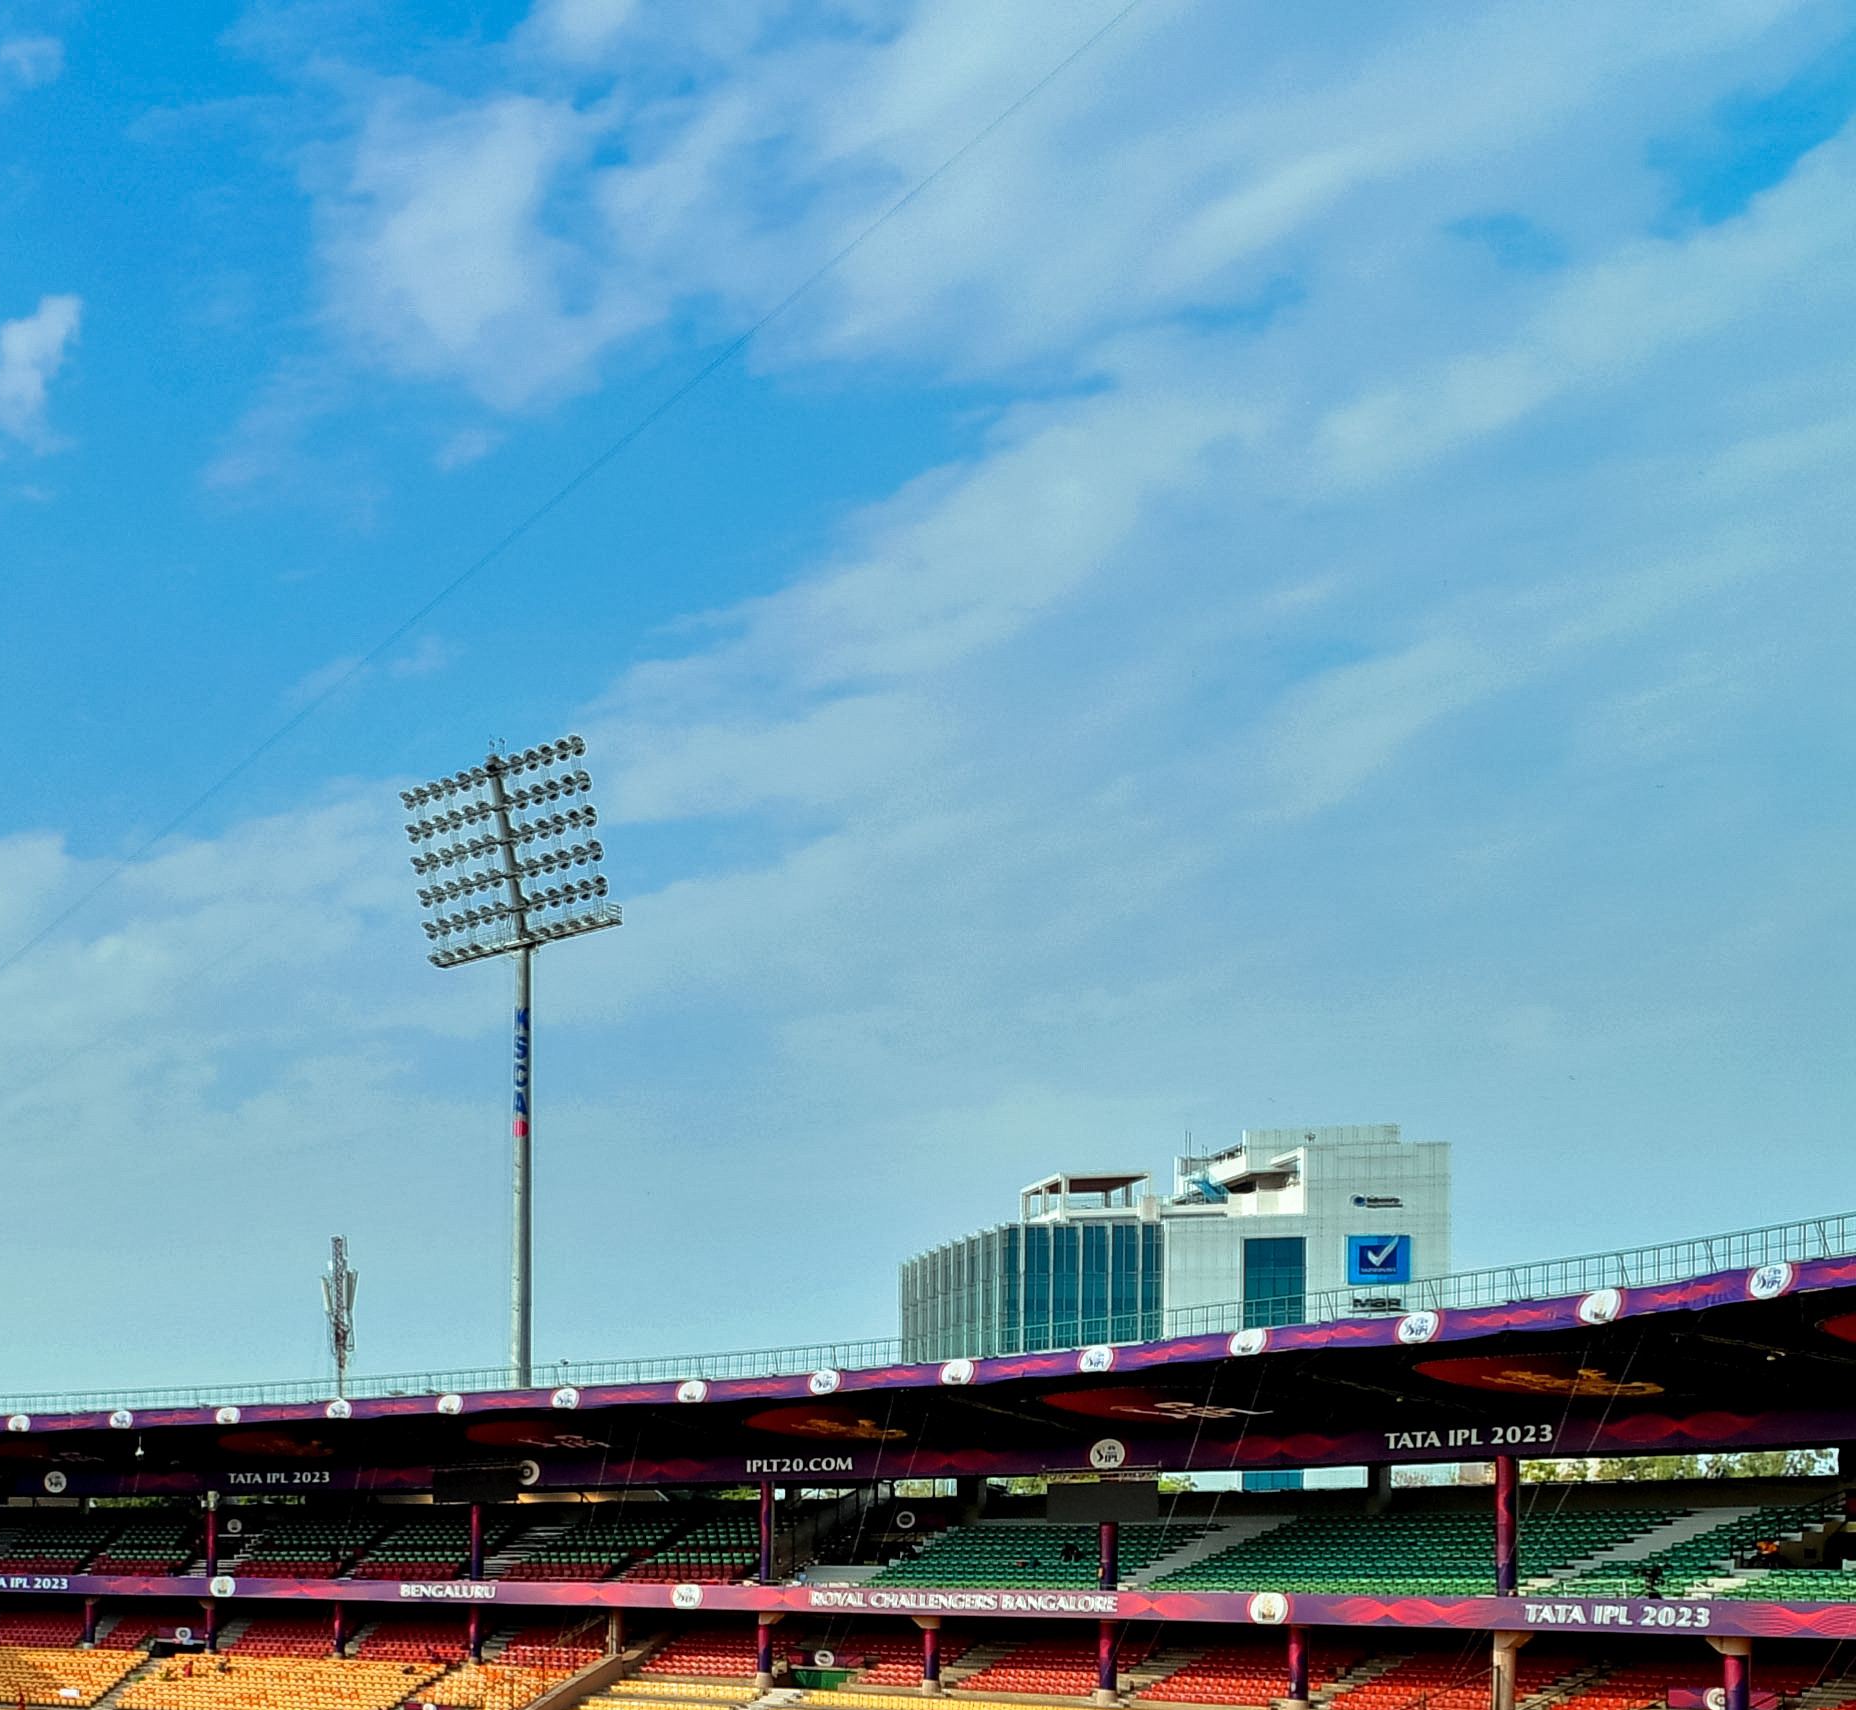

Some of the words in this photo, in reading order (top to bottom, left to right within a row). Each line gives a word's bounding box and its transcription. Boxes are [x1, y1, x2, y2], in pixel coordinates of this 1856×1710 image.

[1384, 1431, 1442, 1450] TATA
[1448, 1428, 1484, 1447] IPL
[1490, 1424, 1554, 1445] 2023
[746, 1457, 854, 1473] IPLT20.COM
[228, 1472, 263, 1484] TATA
[267, 1472, 289, 1484] IPL
[292, 1471, 331, 1484] 2023
[10, 1577, 31, 1589] IPL
[33, 1578, 69, 1590] 2023
[400, 1584, 497, 1599] BENGALURU
[810, 1590, 868, 1607] ROYAL
[870, 1593, 997, 1610] CHALLENGERS
[1002, 1595, 1119, 1612] BANGALORE
[1524, 1603, 1587, 1624] TATA
[1591, 1604, 1634, 1625] IPL
[1640, 1605, 1711, 1627] 2023
